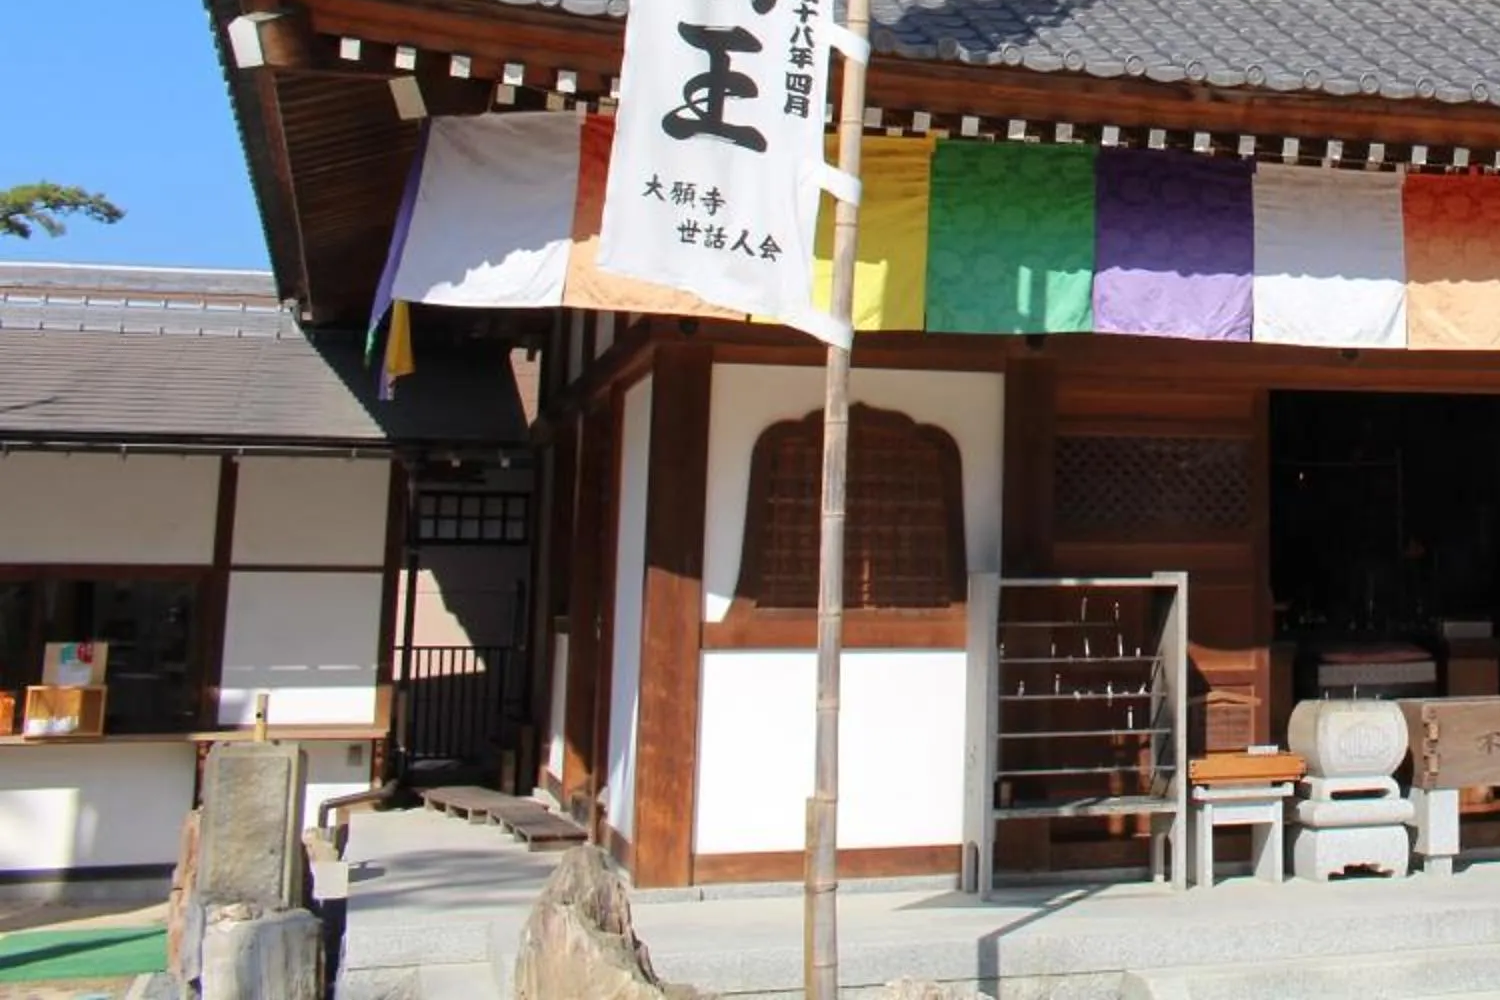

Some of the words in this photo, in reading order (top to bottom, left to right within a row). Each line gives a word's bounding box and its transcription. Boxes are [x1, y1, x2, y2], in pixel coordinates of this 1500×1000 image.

[642, 173, 727, 217] 大願寺
[676, 218, 783, 262] 世話人会
